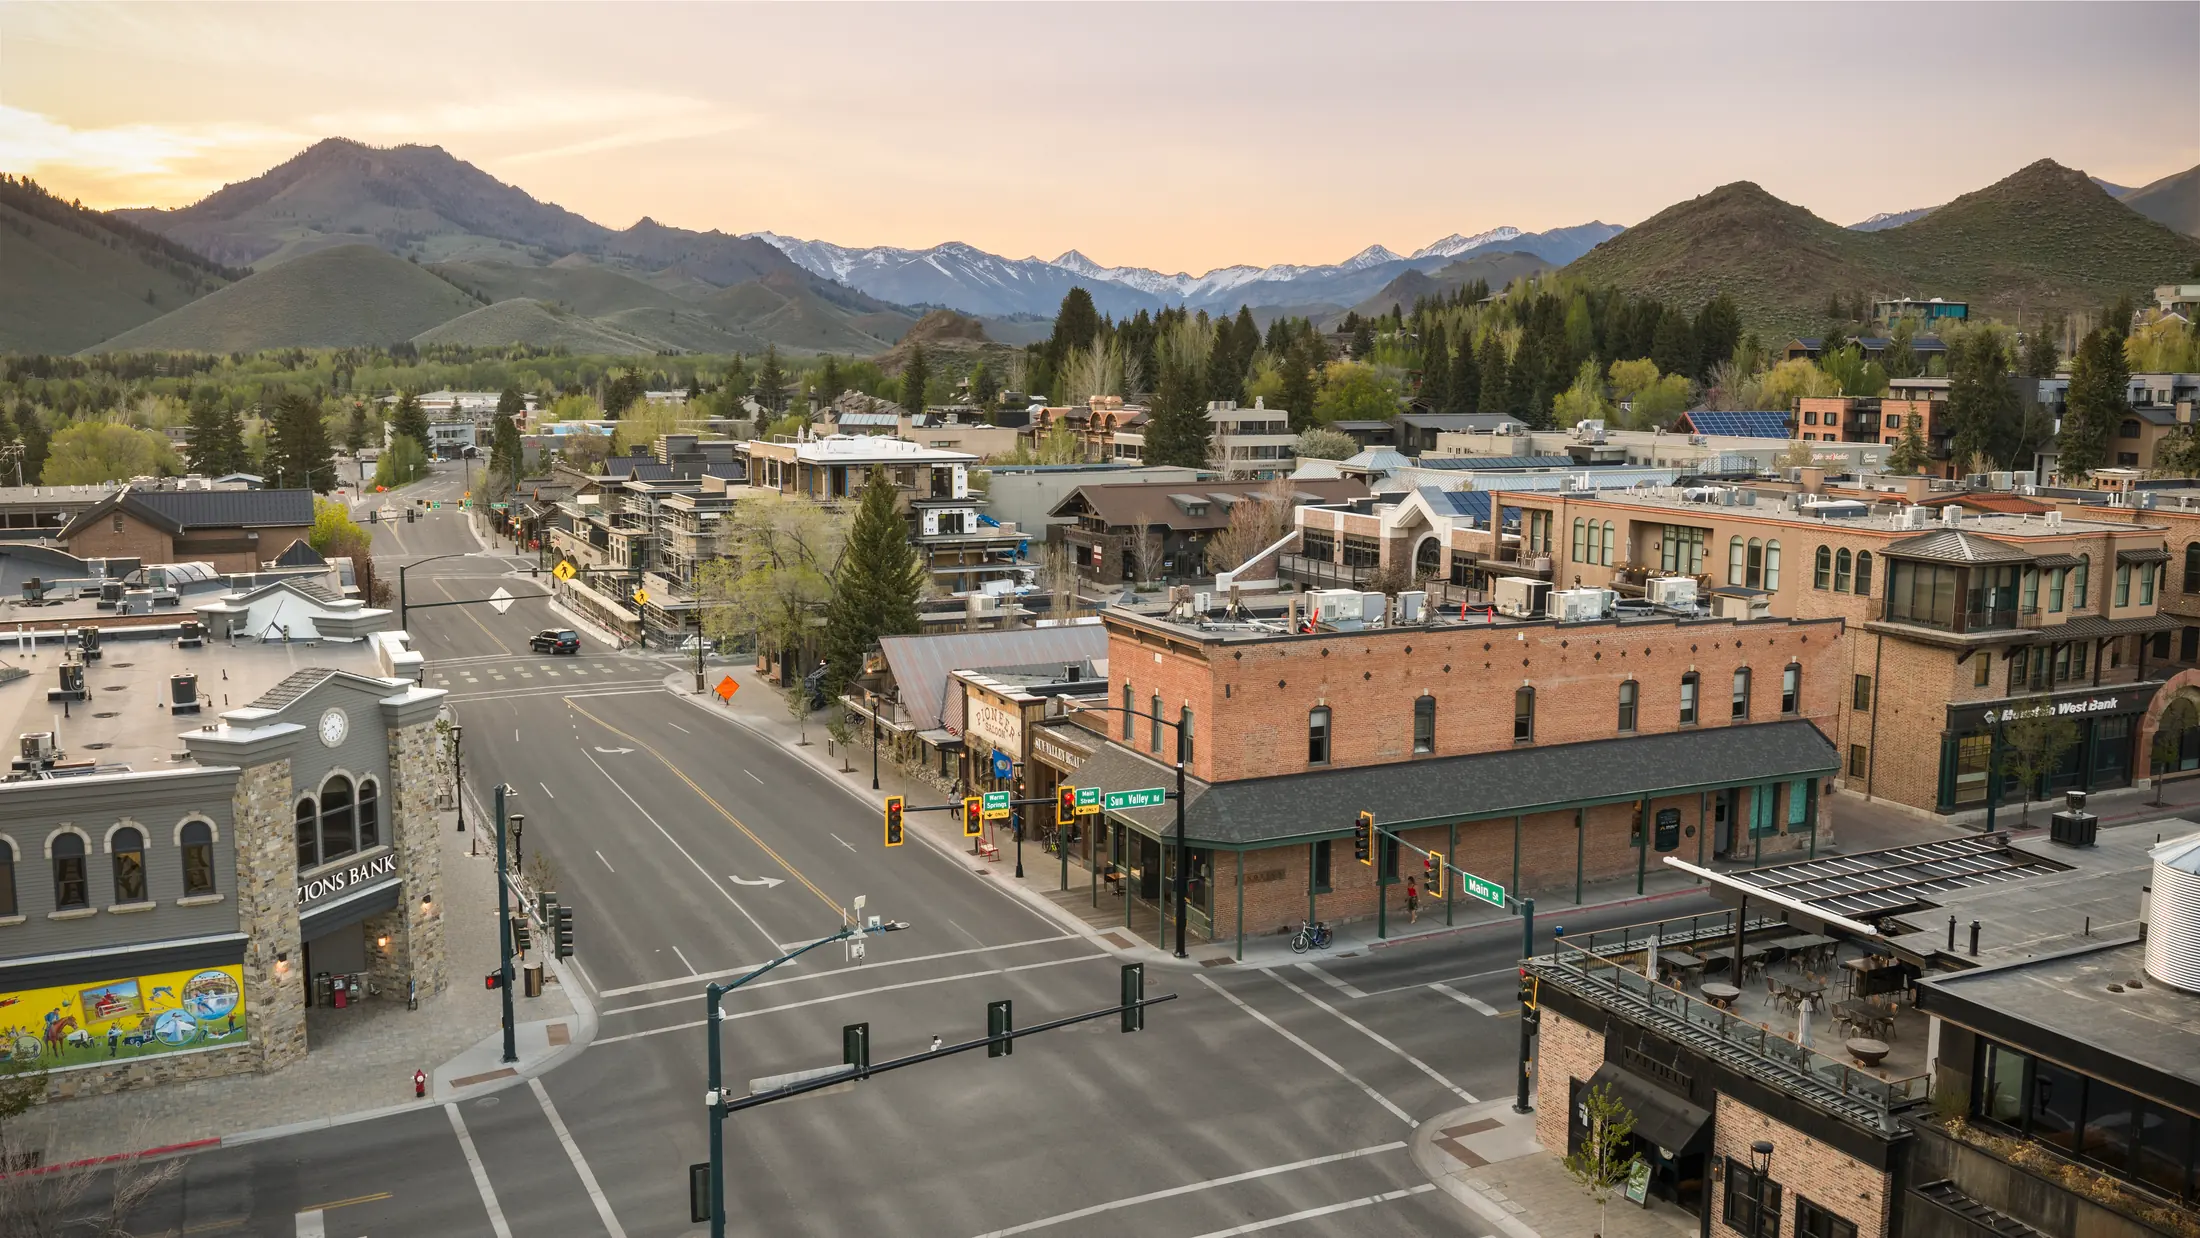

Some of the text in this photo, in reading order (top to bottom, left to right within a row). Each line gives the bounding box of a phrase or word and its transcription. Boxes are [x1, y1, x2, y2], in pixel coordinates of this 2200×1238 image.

[2058, 701, 2087, 714] West
[2088, 697, 2118, 711] Bank
[976, 707, 1015, 742] PIONEER
[985, 722, 1006, 739] SALOON
[1110, 796, 1124, 806] Sun
[1128, 794, 1149, 805] Valley
[349, 854, 397, 885] BANK
[1469, 879, 1499, 901] Main St
